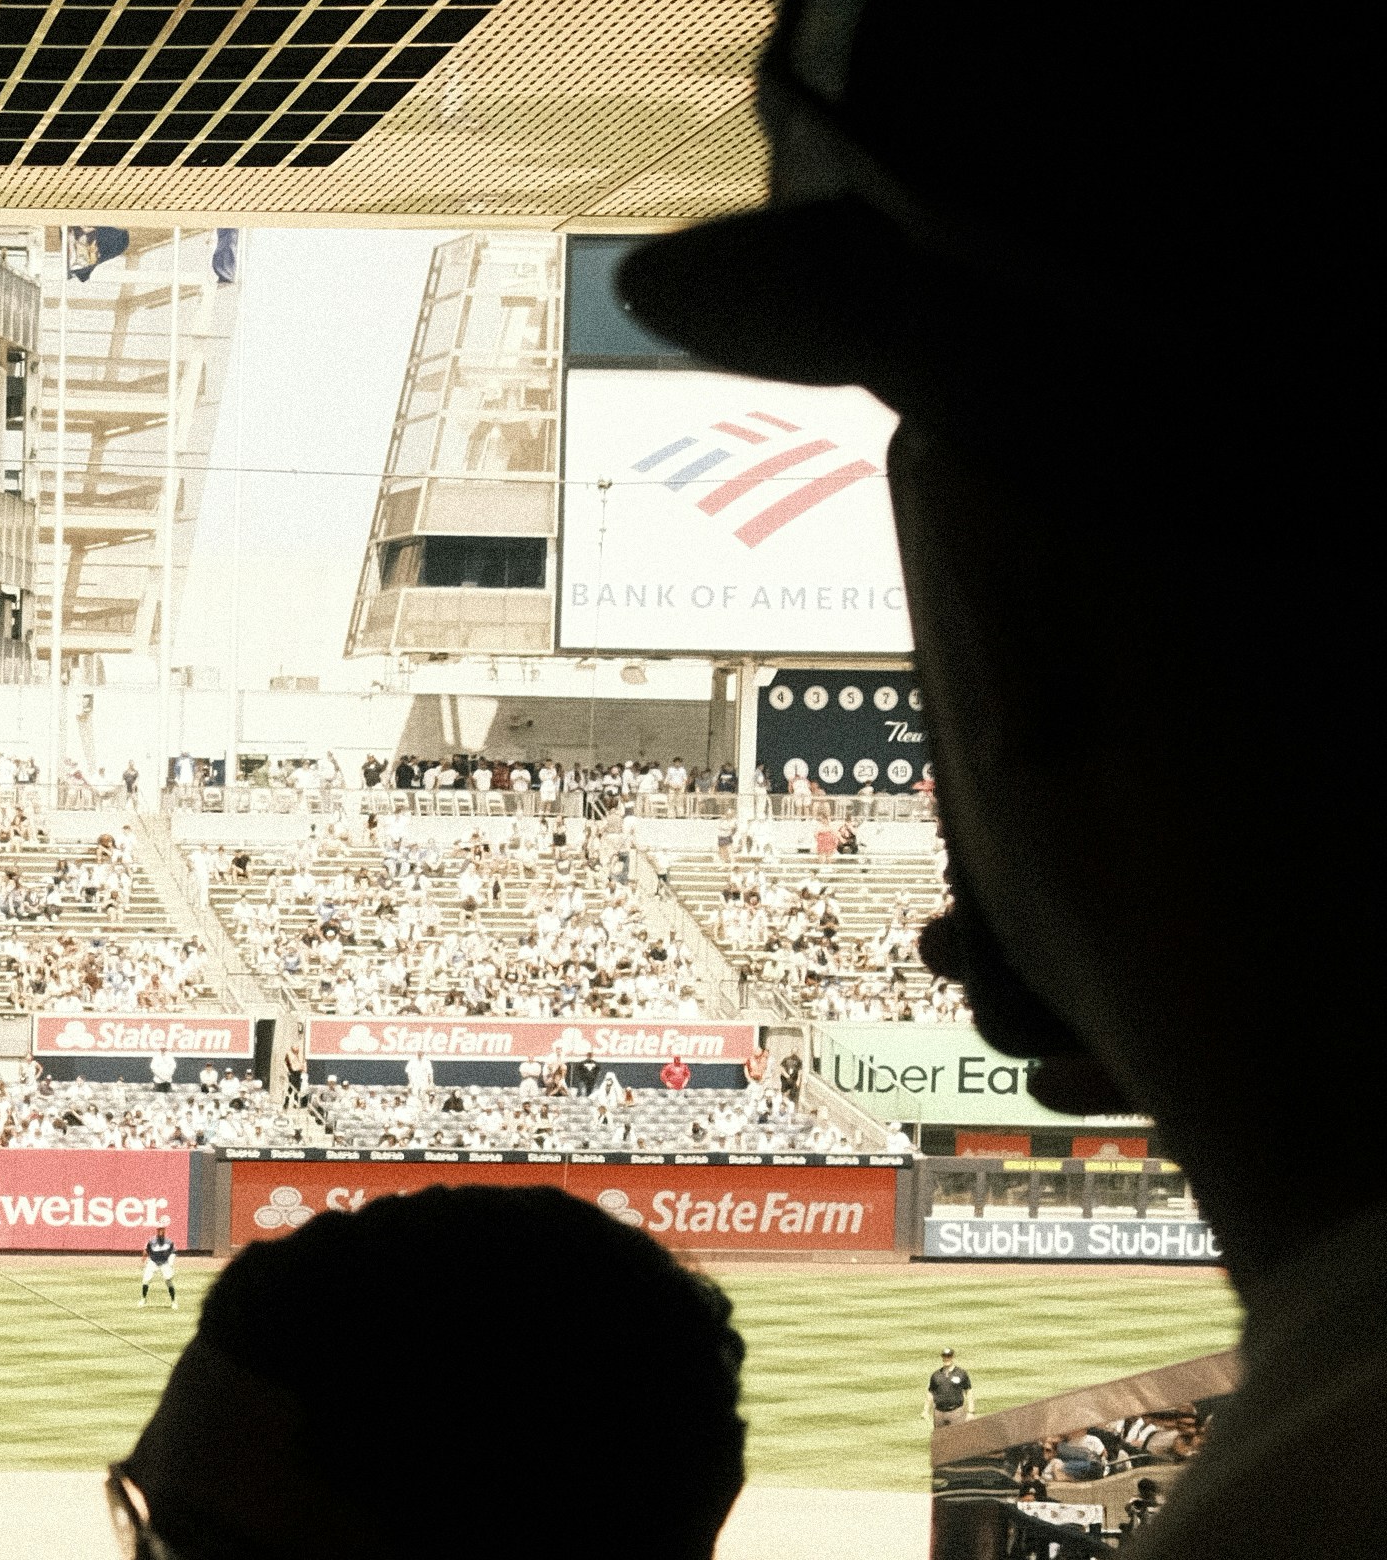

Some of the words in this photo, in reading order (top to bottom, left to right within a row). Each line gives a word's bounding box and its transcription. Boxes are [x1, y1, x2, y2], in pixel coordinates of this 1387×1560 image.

[570, 582, 675, 608] BANK
[689, 584, 738, 609] OF
[750, 586, 903, 610] AMERIC
[834, 1055, 945, 1094] Uber
[938, 1223, 1074, 1255] StubHub
